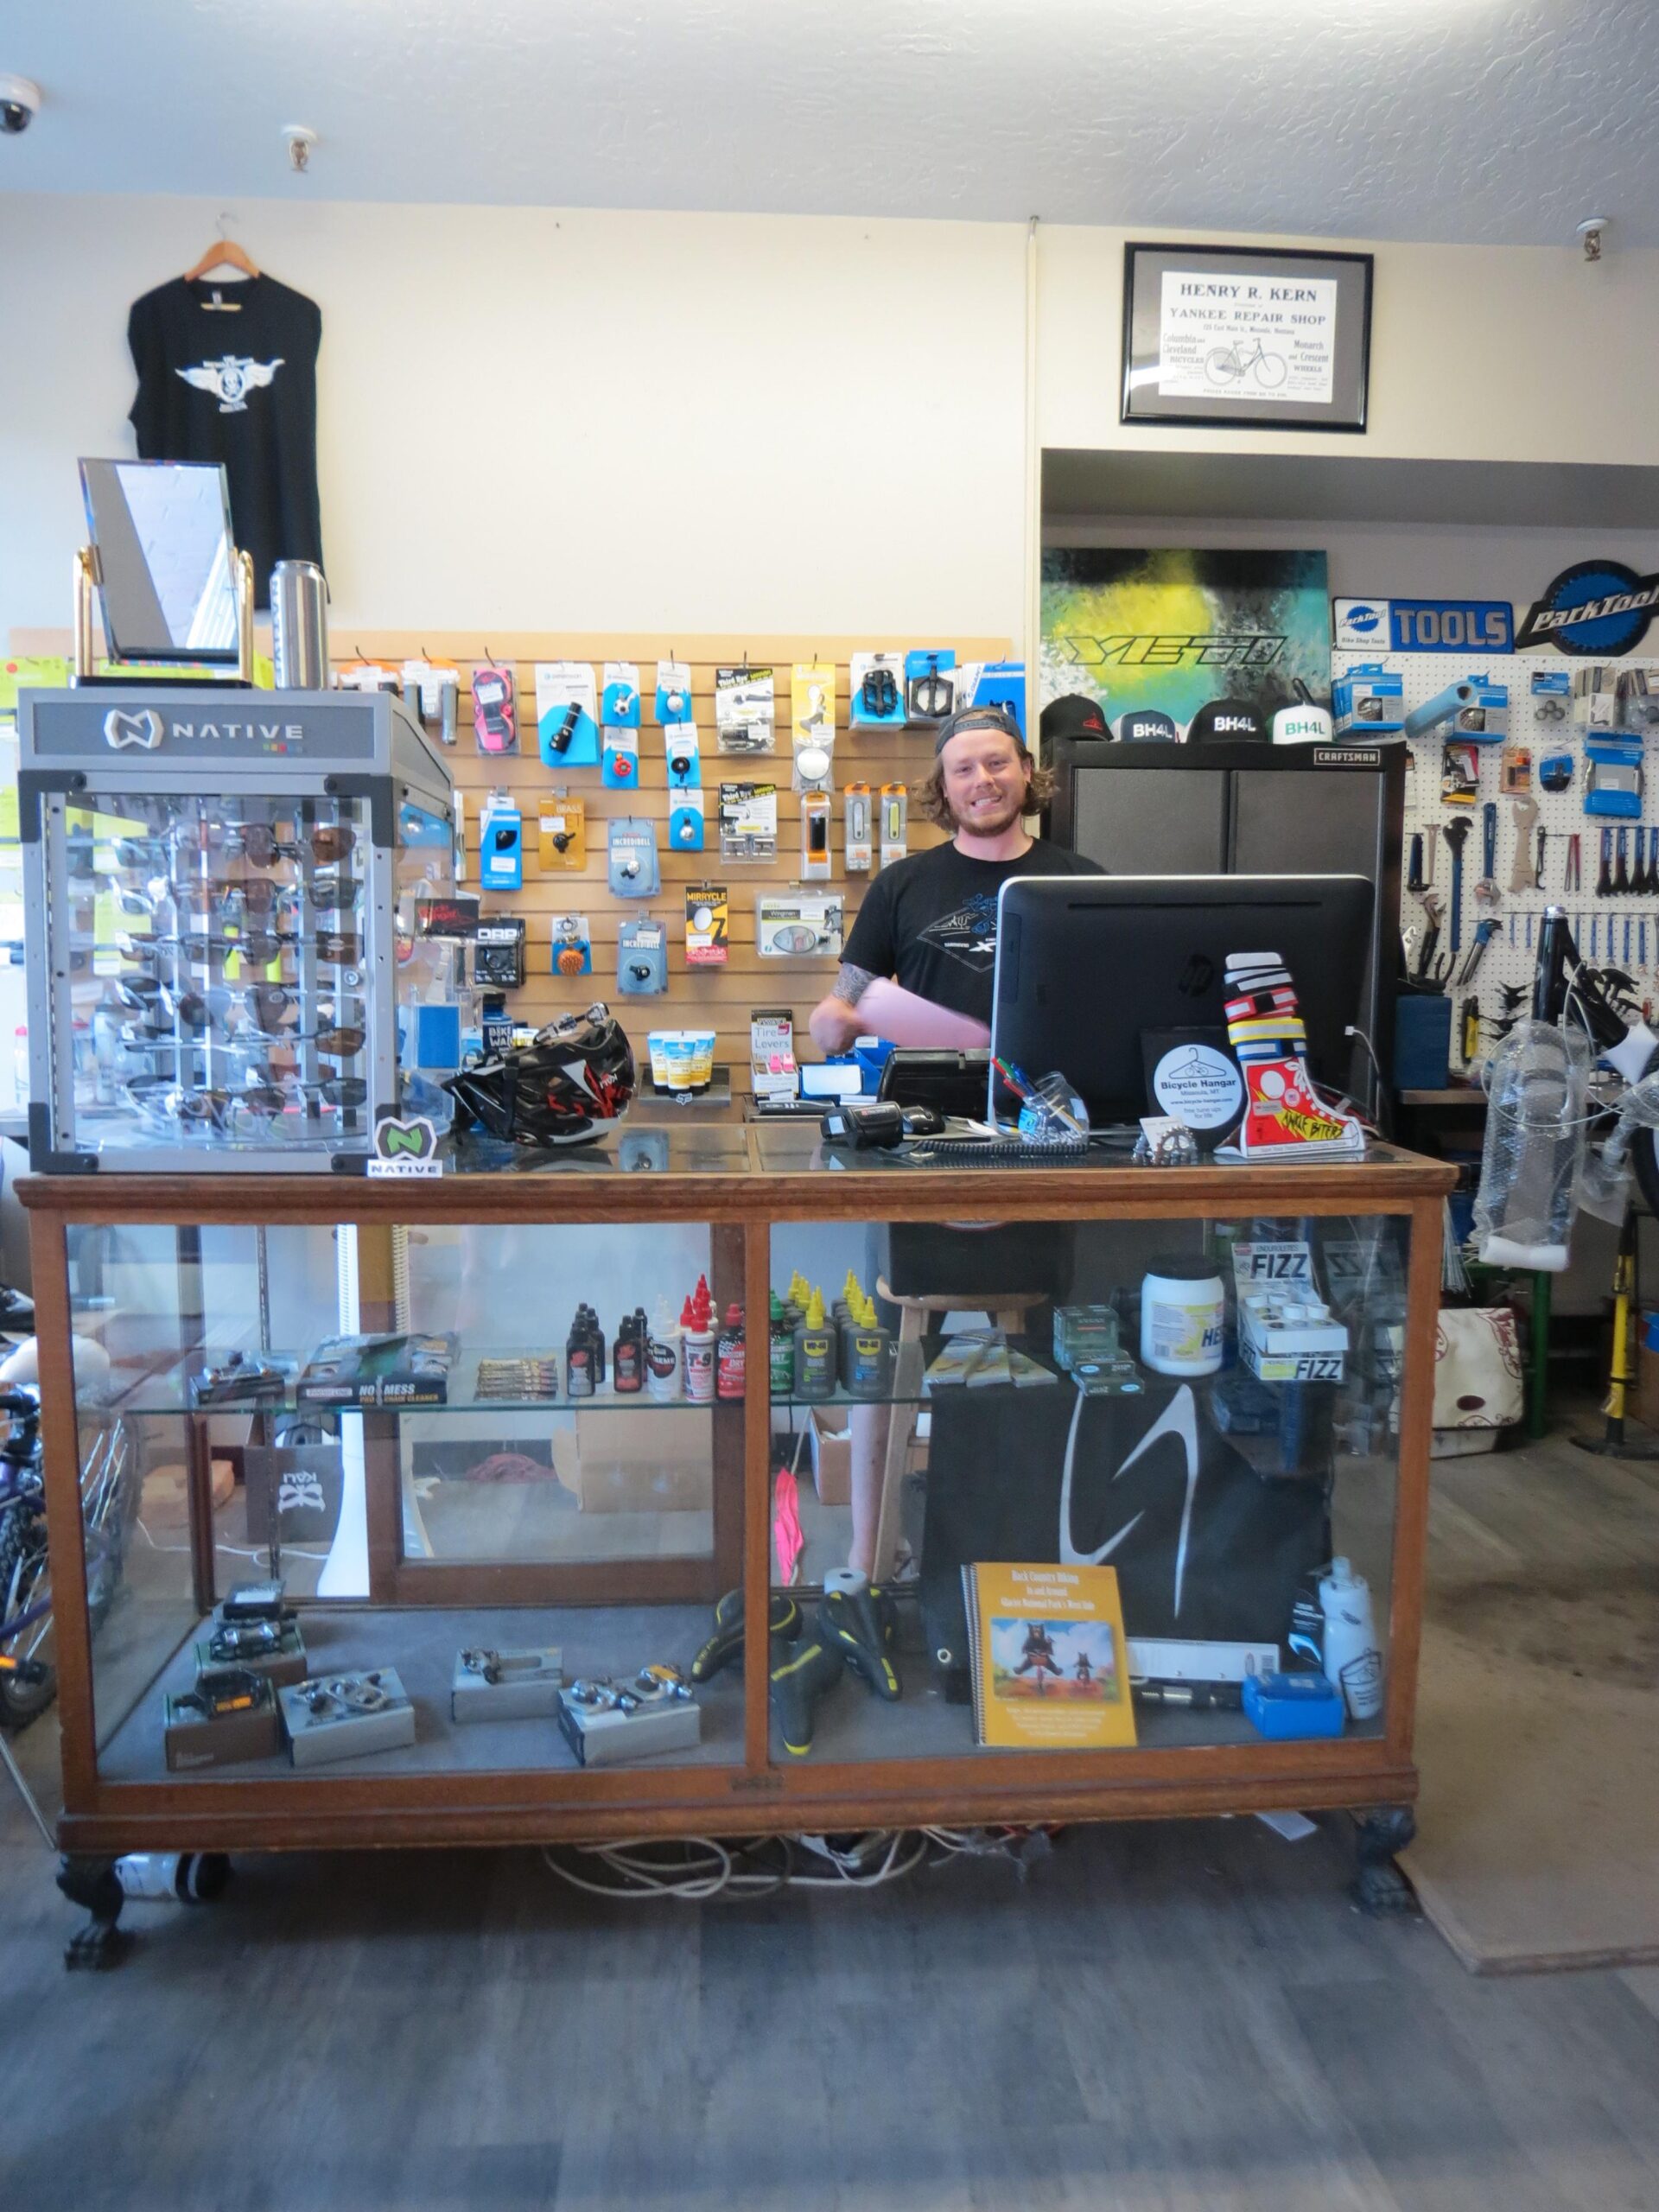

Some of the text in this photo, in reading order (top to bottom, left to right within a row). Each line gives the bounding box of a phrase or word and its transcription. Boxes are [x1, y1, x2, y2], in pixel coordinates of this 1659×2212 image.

[1180, 283, 1317, 302] HENRY R. KERN
[1170, 308, 1326, 326] YANKEE REPAIR SHOP
[1163, 333, 1196, 344] Columbia
[1163, 343, 1197, 354] Cleveland
[1294, 340, 1324, 351] Monarch
[1170, 355, 1205, 364] BICYCLES
[1300, 353, 1329, 363] Crescent
[1294, 365, 1323, 373] WHEELS
[1394, 608, 1508, 646] TOOLS
[1065, 634, 1288, 665] YETI
[1214, 716, 1256, 732] BH4L
[1285, 720, 1325, 736] BH4L
[173, 723, 303, 739] NATIVE
[1133, 723, 1173, 739] BH4L
[1319, 751, 1376, 763] CRAFTSMAN
[687, 892, 727, 901] MIRRYCLE
[488, 1026, 512, 1037] BIKE
[755, 1027, 777, 1037] Tire
[754, 1039, 790, 1049] Levers
[1161, 1079, 1236, 1090] Bicycle Hangar
[1250, 1253, 1308, 1279] FIZZ
[688, 1352, 712, 1367] T-9
[1296, 1359, 1342, 1379] FIZZ
[359, 1383, 416, 1395] NO MESS
